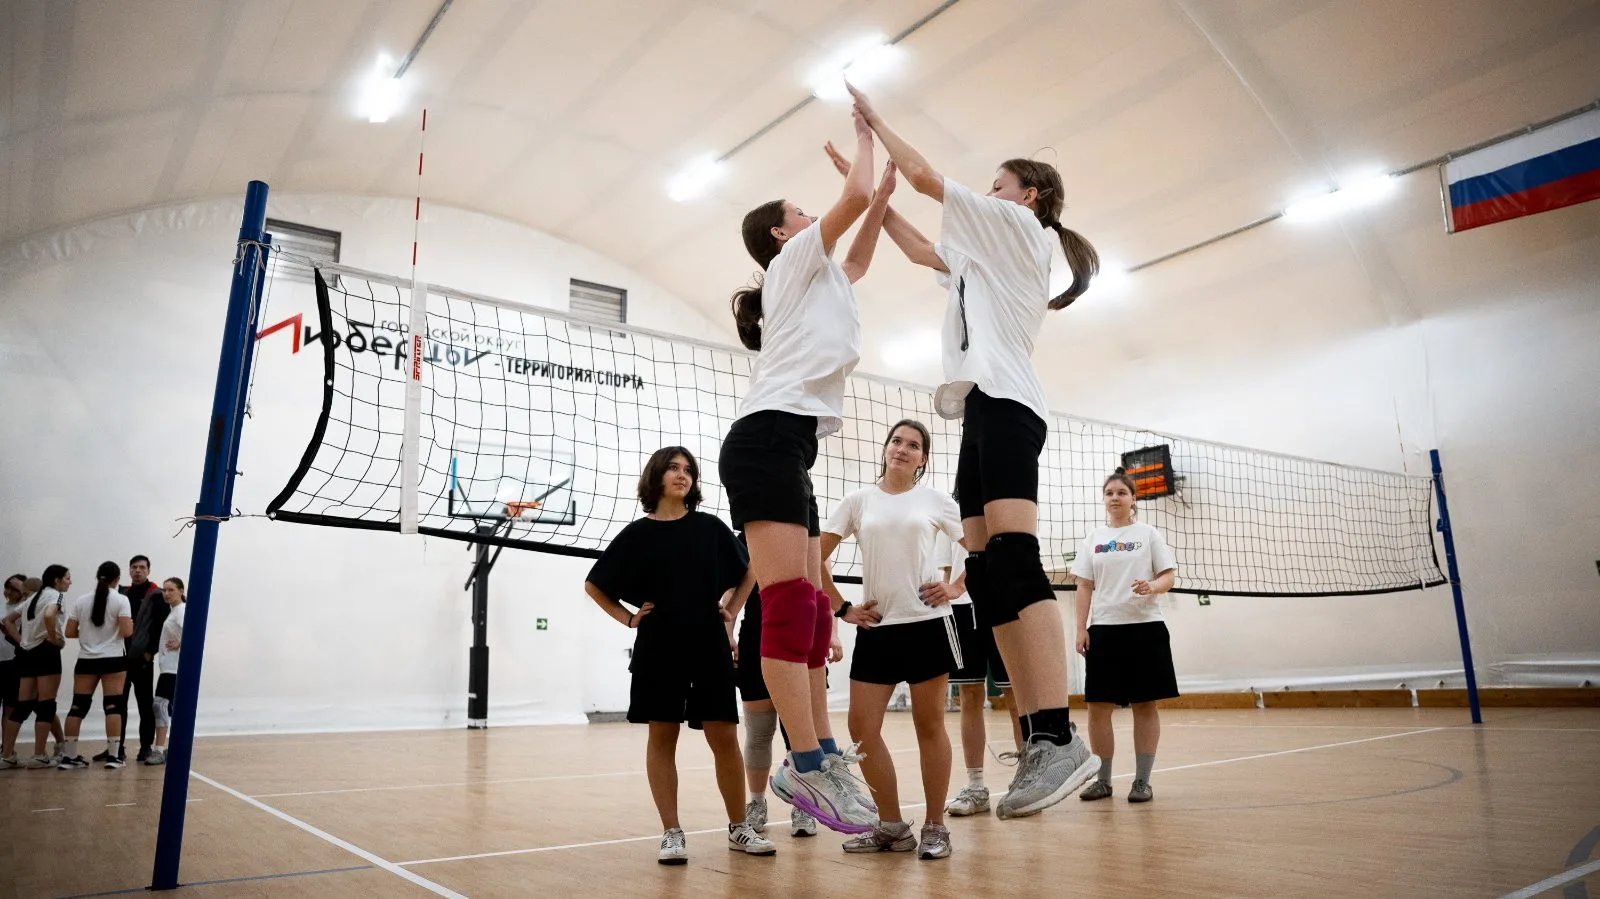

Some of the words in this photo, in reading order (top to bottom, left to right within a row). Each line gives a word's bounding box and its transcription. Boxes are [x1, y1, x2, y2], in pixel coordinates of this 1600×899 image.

[381, 320, 470, 342] горской
[506, 356, 593, 383] ТЕРРИТОРИЯ
[597, 370, 645, 390] СПОРТА
